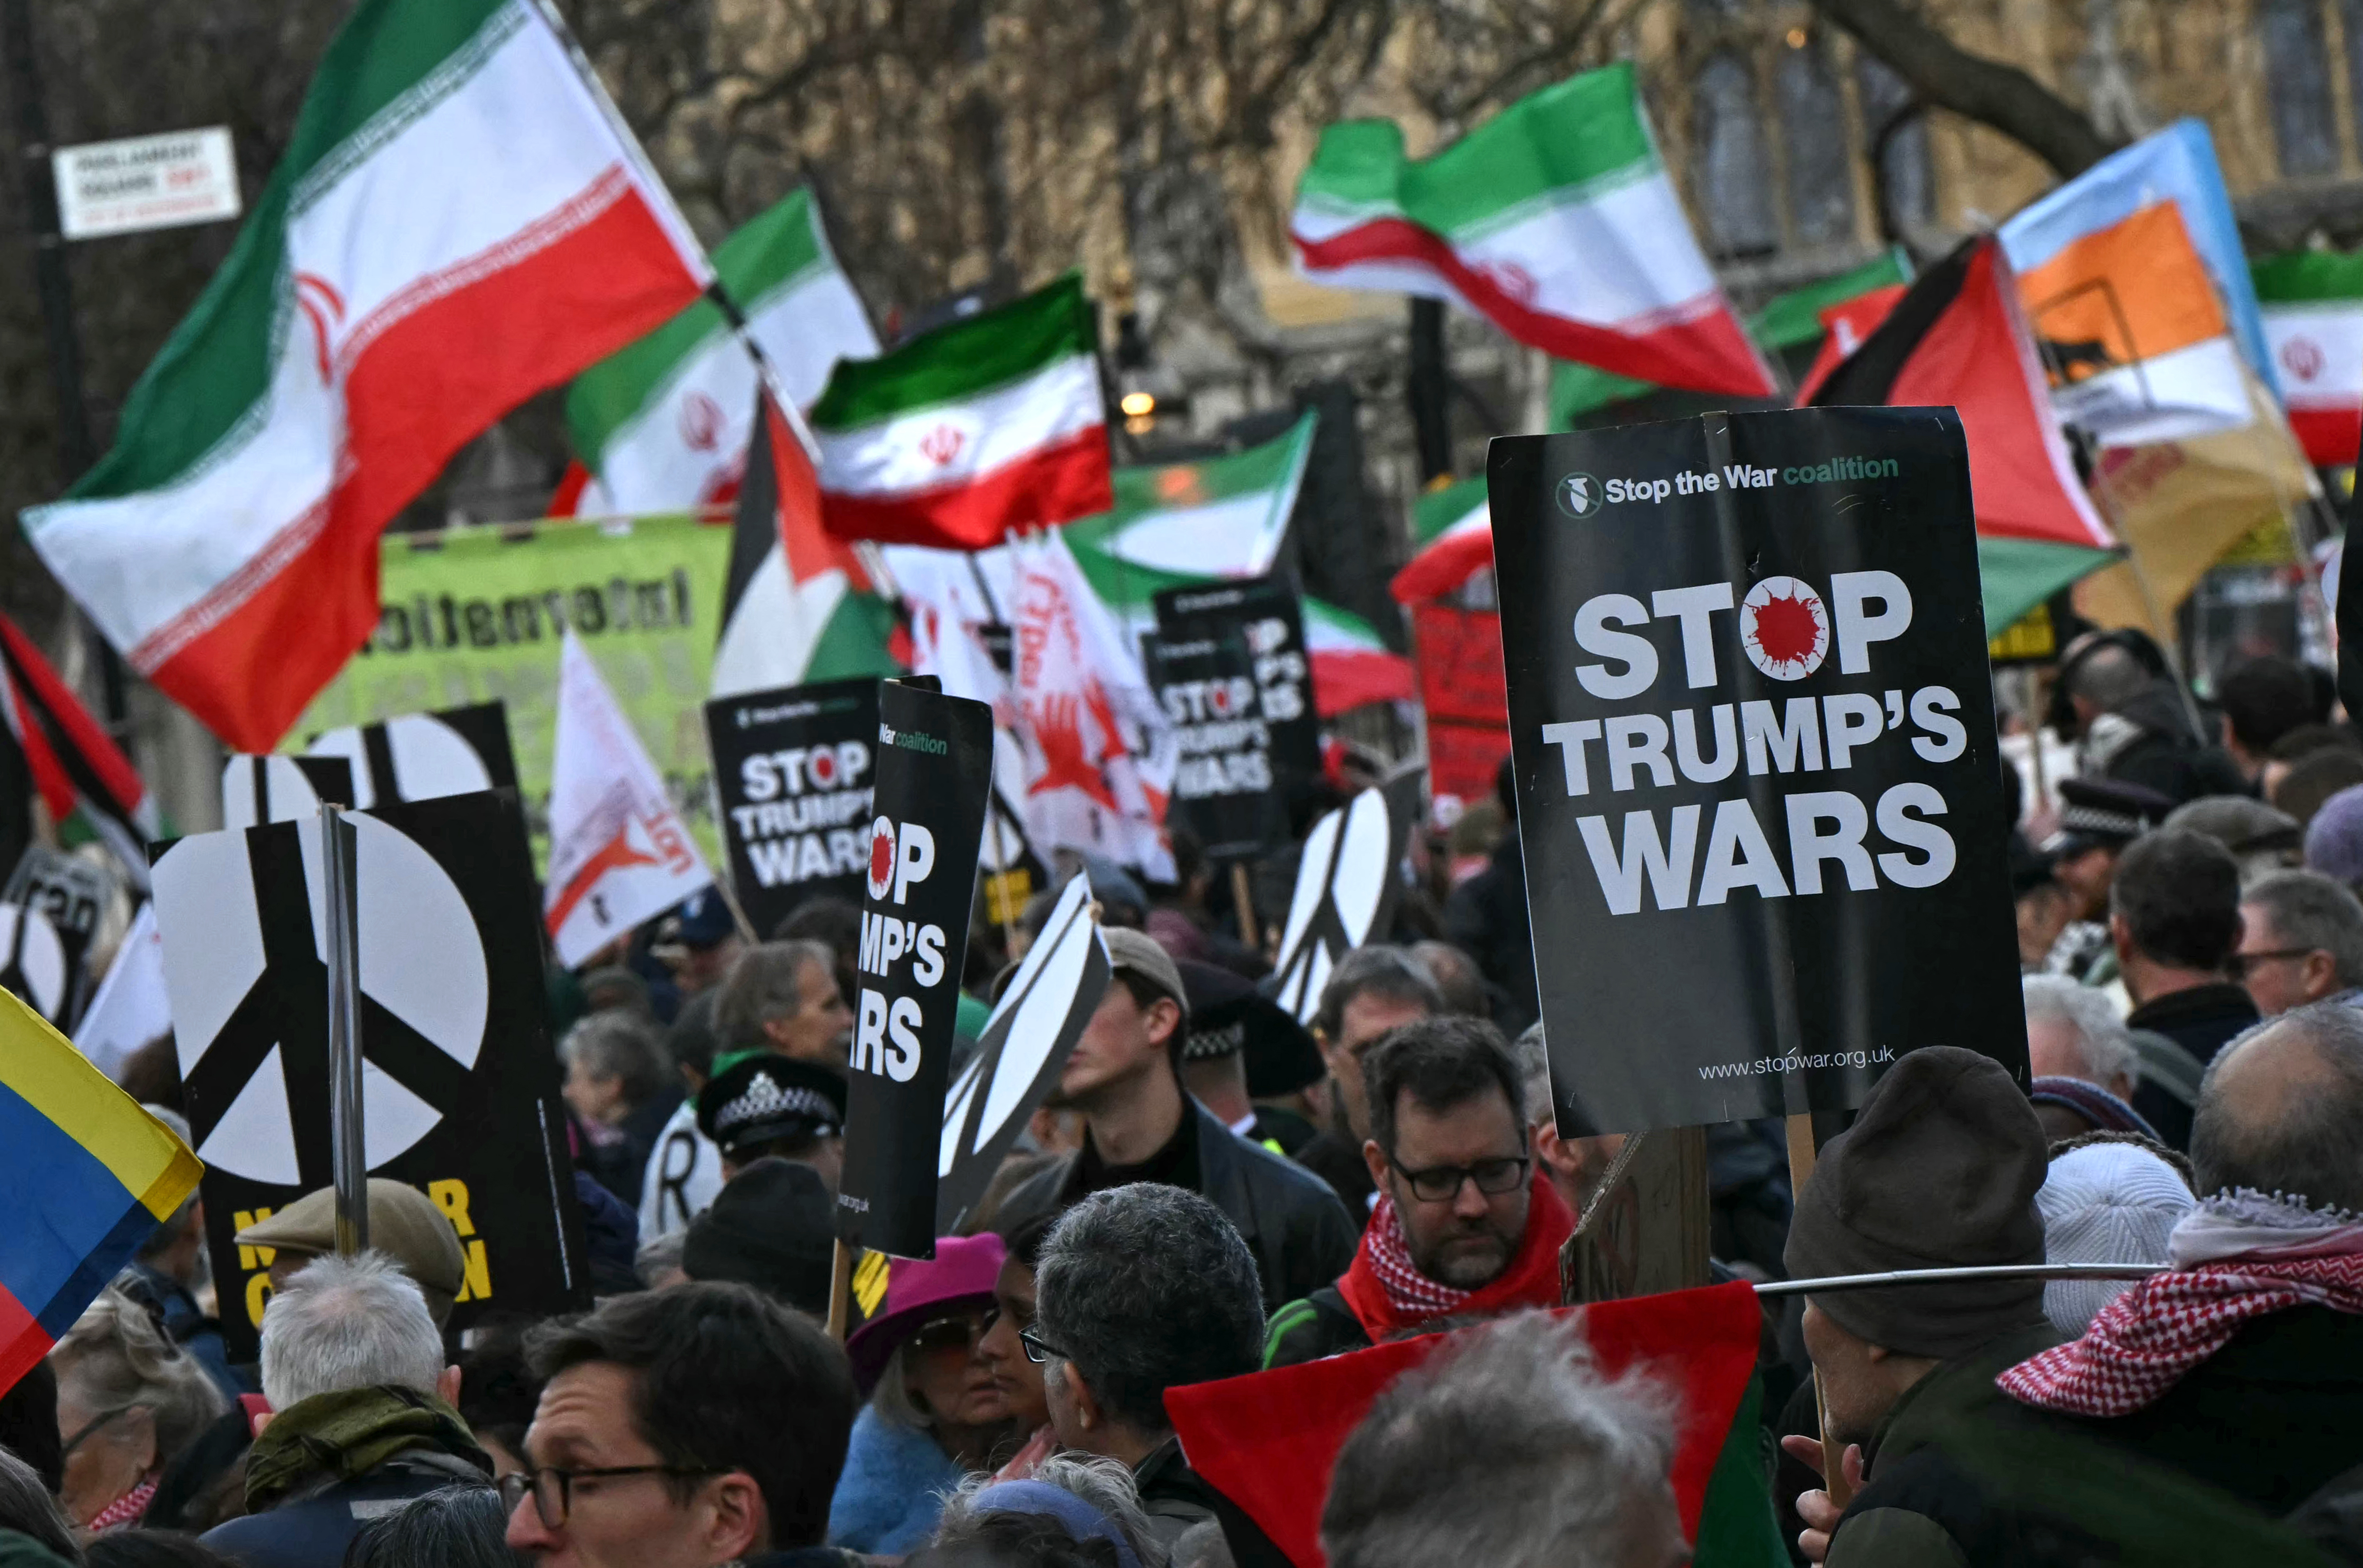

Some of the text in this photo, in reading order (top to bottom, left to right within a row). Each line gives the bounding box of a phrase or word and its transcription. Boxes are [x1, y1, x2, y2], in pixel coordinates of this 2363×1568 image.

[1605, 456, 1898, 504] Stop the War coalition
[1573, 570, 1913, 700] STOP
[1161, 676, 1257, 724] STOP
[741, 741, 871, 801] STOP
[896, 732, 947, 755] coalition
[1542, 686, 1967, 796] TRUMP'S
[730, 787, 874, 842] TRUMP'
[1576, 782, 1956, 915] WARS
[868, 815, 935, 905] OP
[858, 910, 946, 987] MP'S
[849, 988, 923, 1083] RS
[1699, 1045, 1896, 1080] www.stopwar.org.uk
